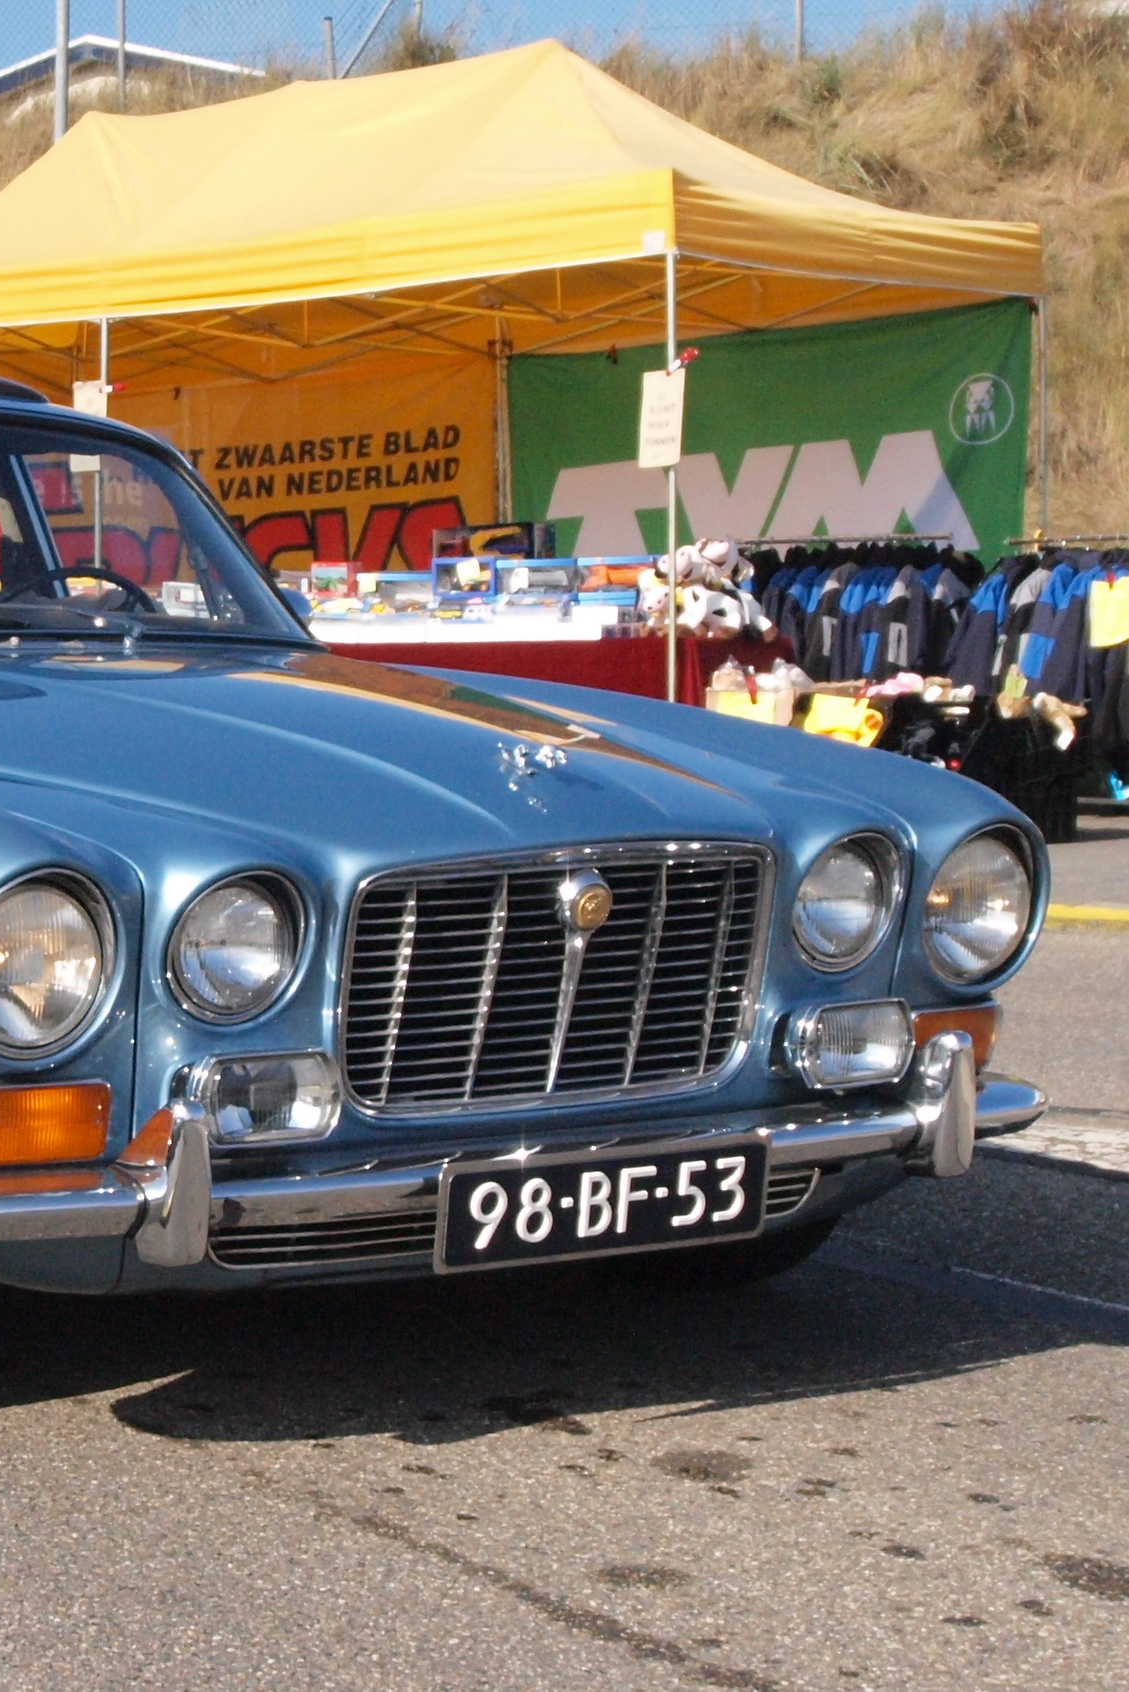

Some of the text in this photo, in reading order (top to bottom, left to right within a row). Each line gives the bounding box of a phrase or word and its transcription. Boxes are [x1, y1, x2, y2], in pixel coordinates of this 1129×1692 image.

[215, 434, 374, 470] ZWAARSTE
[383, 424, 461, 456] BLAD
[218, 457, 460, 501] VAN NEDERLAND
[546, 430, 980, 561] TVM
